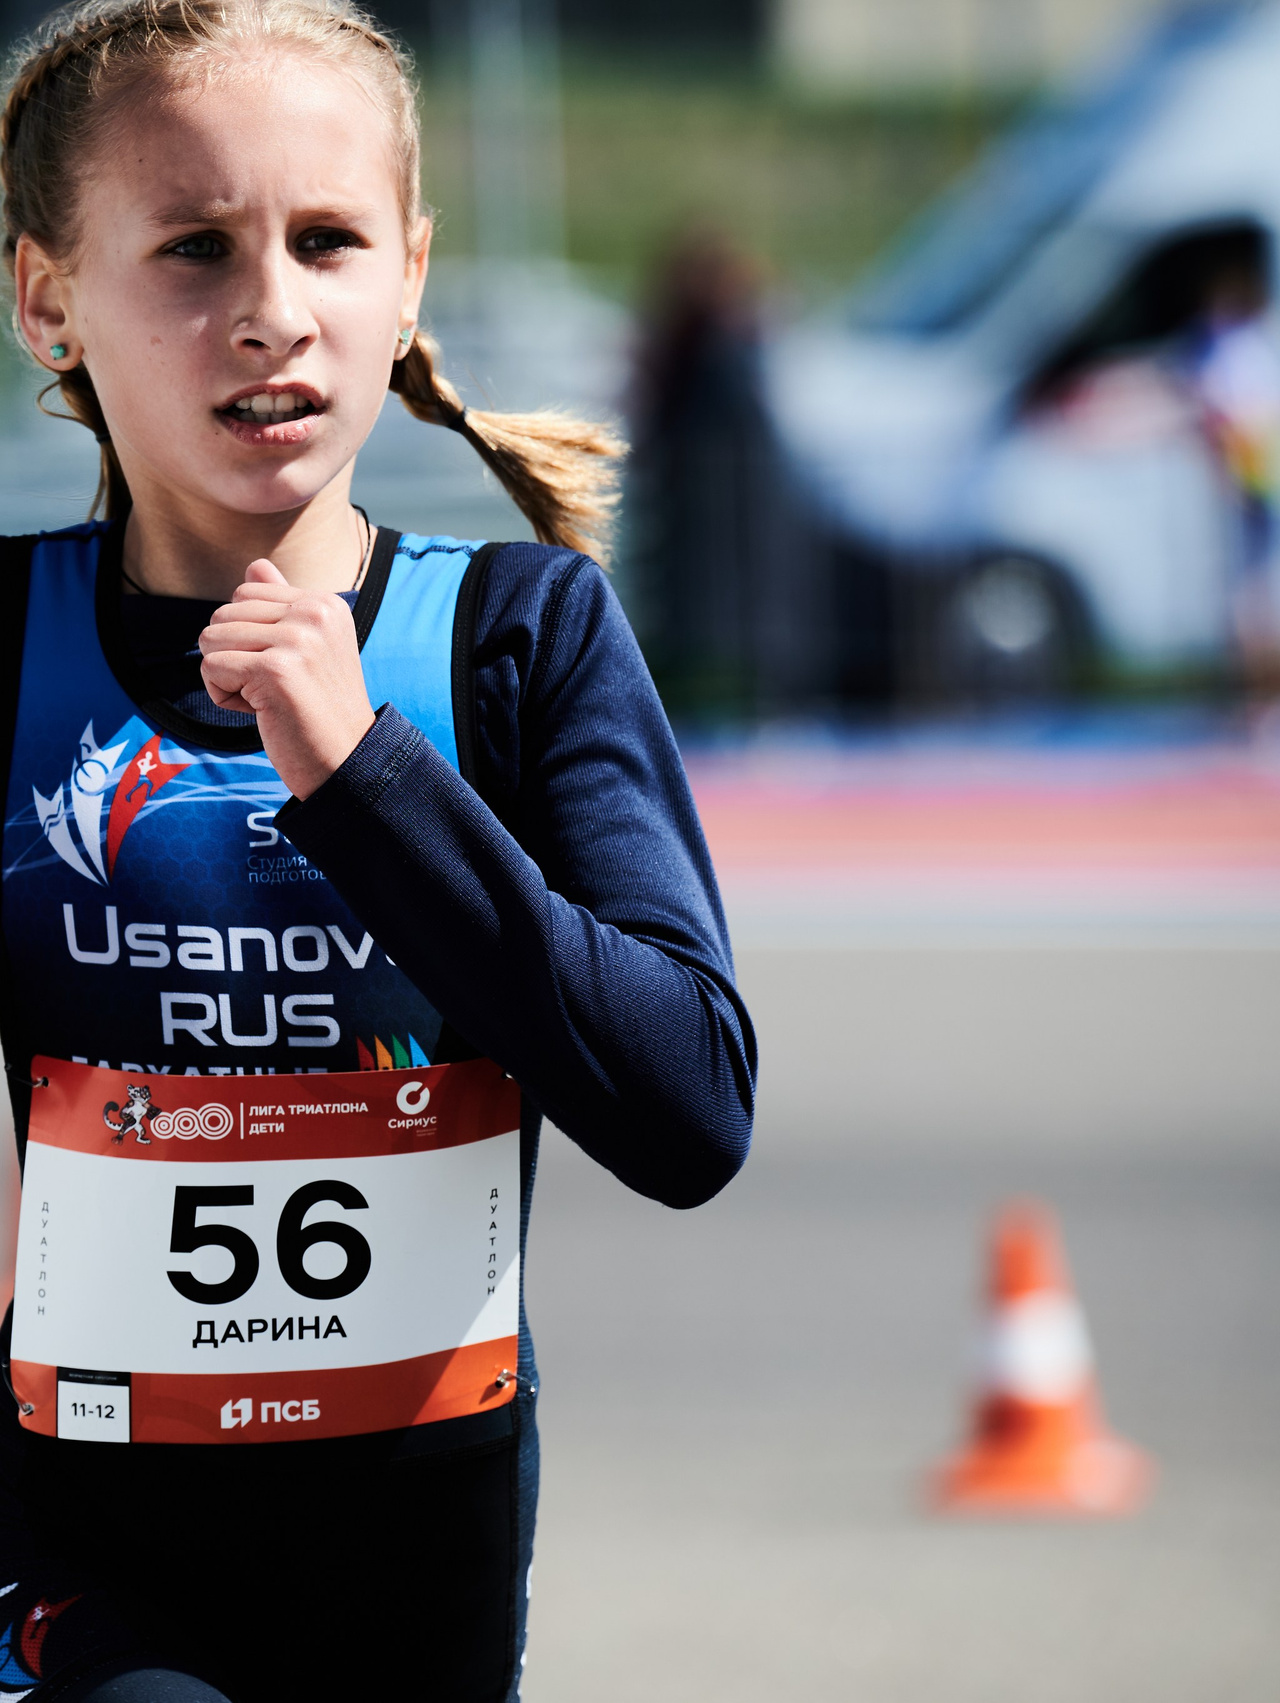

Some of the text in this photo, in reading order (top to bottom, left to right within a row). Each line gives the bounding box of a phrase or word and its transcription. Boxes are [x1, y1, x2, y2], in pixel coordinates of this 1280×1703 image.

[247, 854, 308, 873] Студия
[62, 903, 397, 973] Usanov
[160, 991, 341, 1048] RUS
[248, 1102, 369, 1117] ЛИГА ТРИАТЛОНА
[387, 1116, 437, 1130] Сириус
[248, 1122, 285, 1136] ДЕТИ
[166, 1179, 372, 1306] 56
[486, 1187, 499, 1296] ДУАТЛОН
[37, 1201, 50, 1316] ДУАТЛОН
[192, 1314, 348, 1349] ДАРИНА
[70, 1402, 116, 1420] 11-12
[260, 1398, 321, 1424] ПСБ
